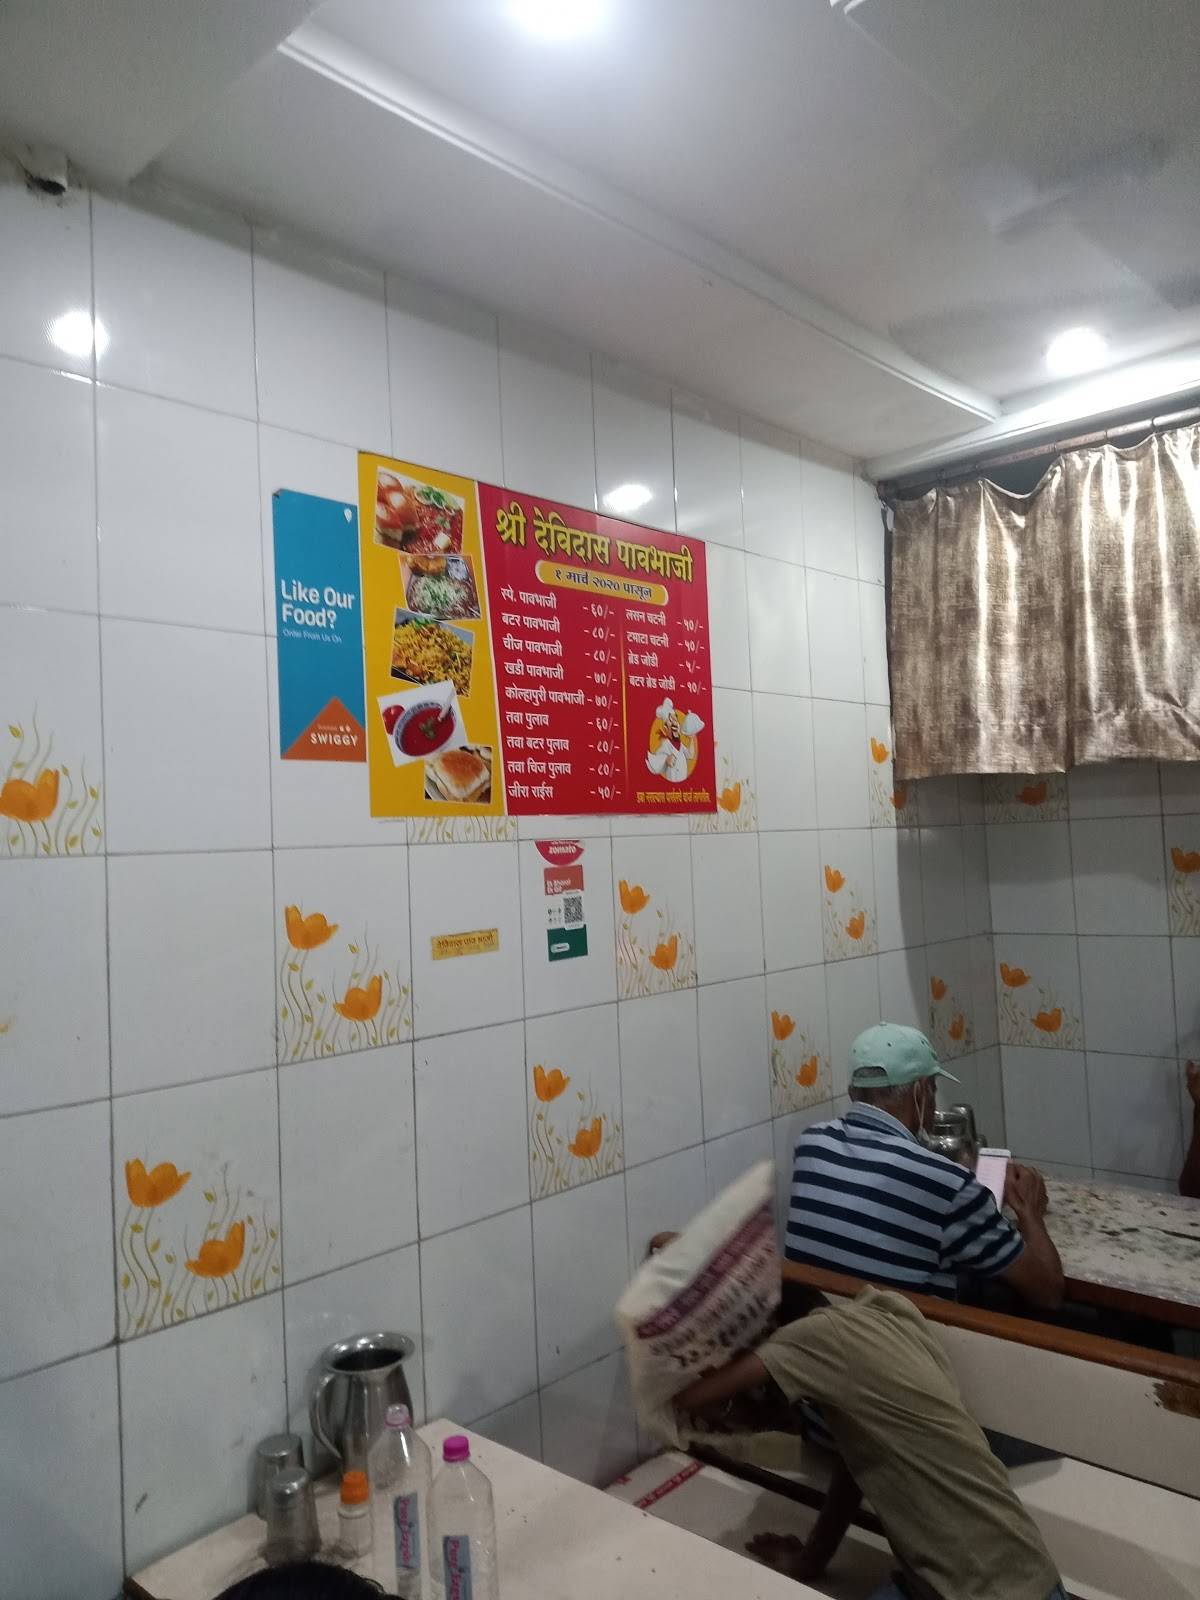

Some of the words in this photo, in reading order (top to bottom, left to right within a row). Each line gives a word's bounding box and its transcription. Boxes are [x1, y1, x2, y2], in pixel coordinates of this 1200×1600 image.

[496, 501, 527, 546] श्री
[533, 506, 610, 565] देविदास
[616, 544, 694, 583] पावभाजी
[281, 579, 320, 605] Like
[324, 586, 355, 610] Our
[566, 570, 590, 585] मार्च
[593, 576, 620, 591] २०२०
[623, 580, 652, 600] पासून
[519, 590, 557, 609] पावभाजी
[282, 602, 337, 629] Food?
[501, 612, 520, 626] बटर
[523, 615, 560, 633] पावभाजी
[502, 633, 523, 651] चीज
[525, 639, 562, 656] पावभाजी
[526, 663, 564, 680] पावभाजी
[505, 683, 546, 706] कोल्हापुरी
[548, 689, 584, 705] पावभाजी
[505, 711, 523, 724] तवा
[525, 712, 549, 730] पुलाव
[310, 732, 358, 747] SWIGGY
[506, 736, 524, 749] तवा
[526, 737, 544, 750] बटर
[546, 738, 569, 755] पुलाव
[507, 761, 525, 774] तवा
[527, 757, 546, 774] चिज
[548, 762, 571, 779] पुलाव
[508, 781, 529, 798] जीरा
[531, 781, 553, 801] राईस
[548, 845, 577, 855] zomato
